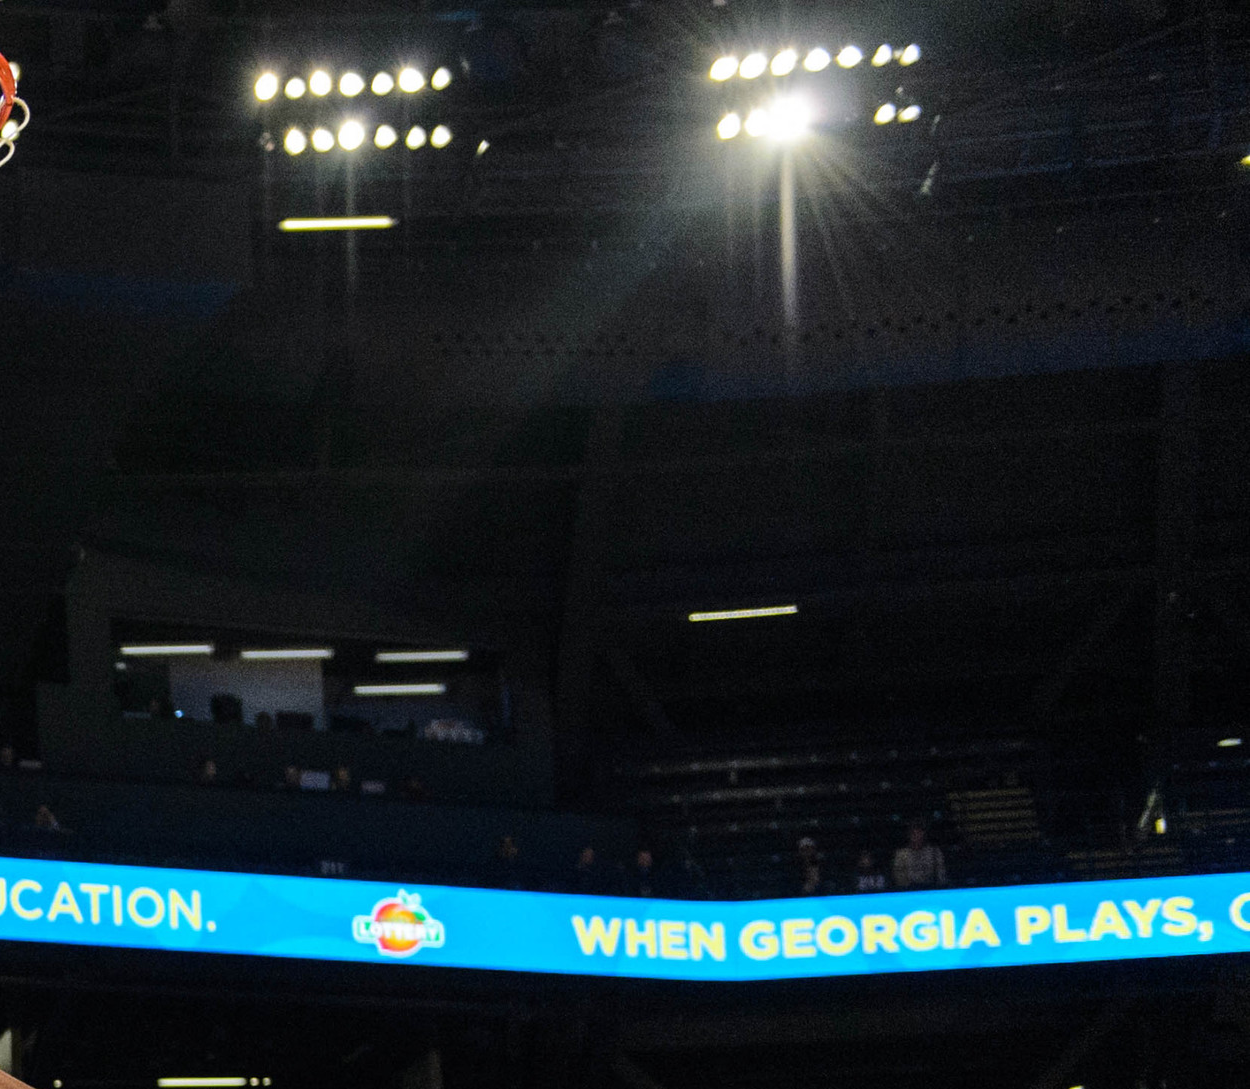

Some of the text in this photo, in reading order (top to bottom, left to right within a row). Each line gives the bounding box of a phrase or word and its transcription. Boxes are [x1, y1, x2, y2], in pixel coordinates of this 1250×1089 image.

[571, 914, 726, 962] WHEN
[740, 908, 1001, 961] GEORGIA
[1015, 896, 1214, 945] PLAYS,
